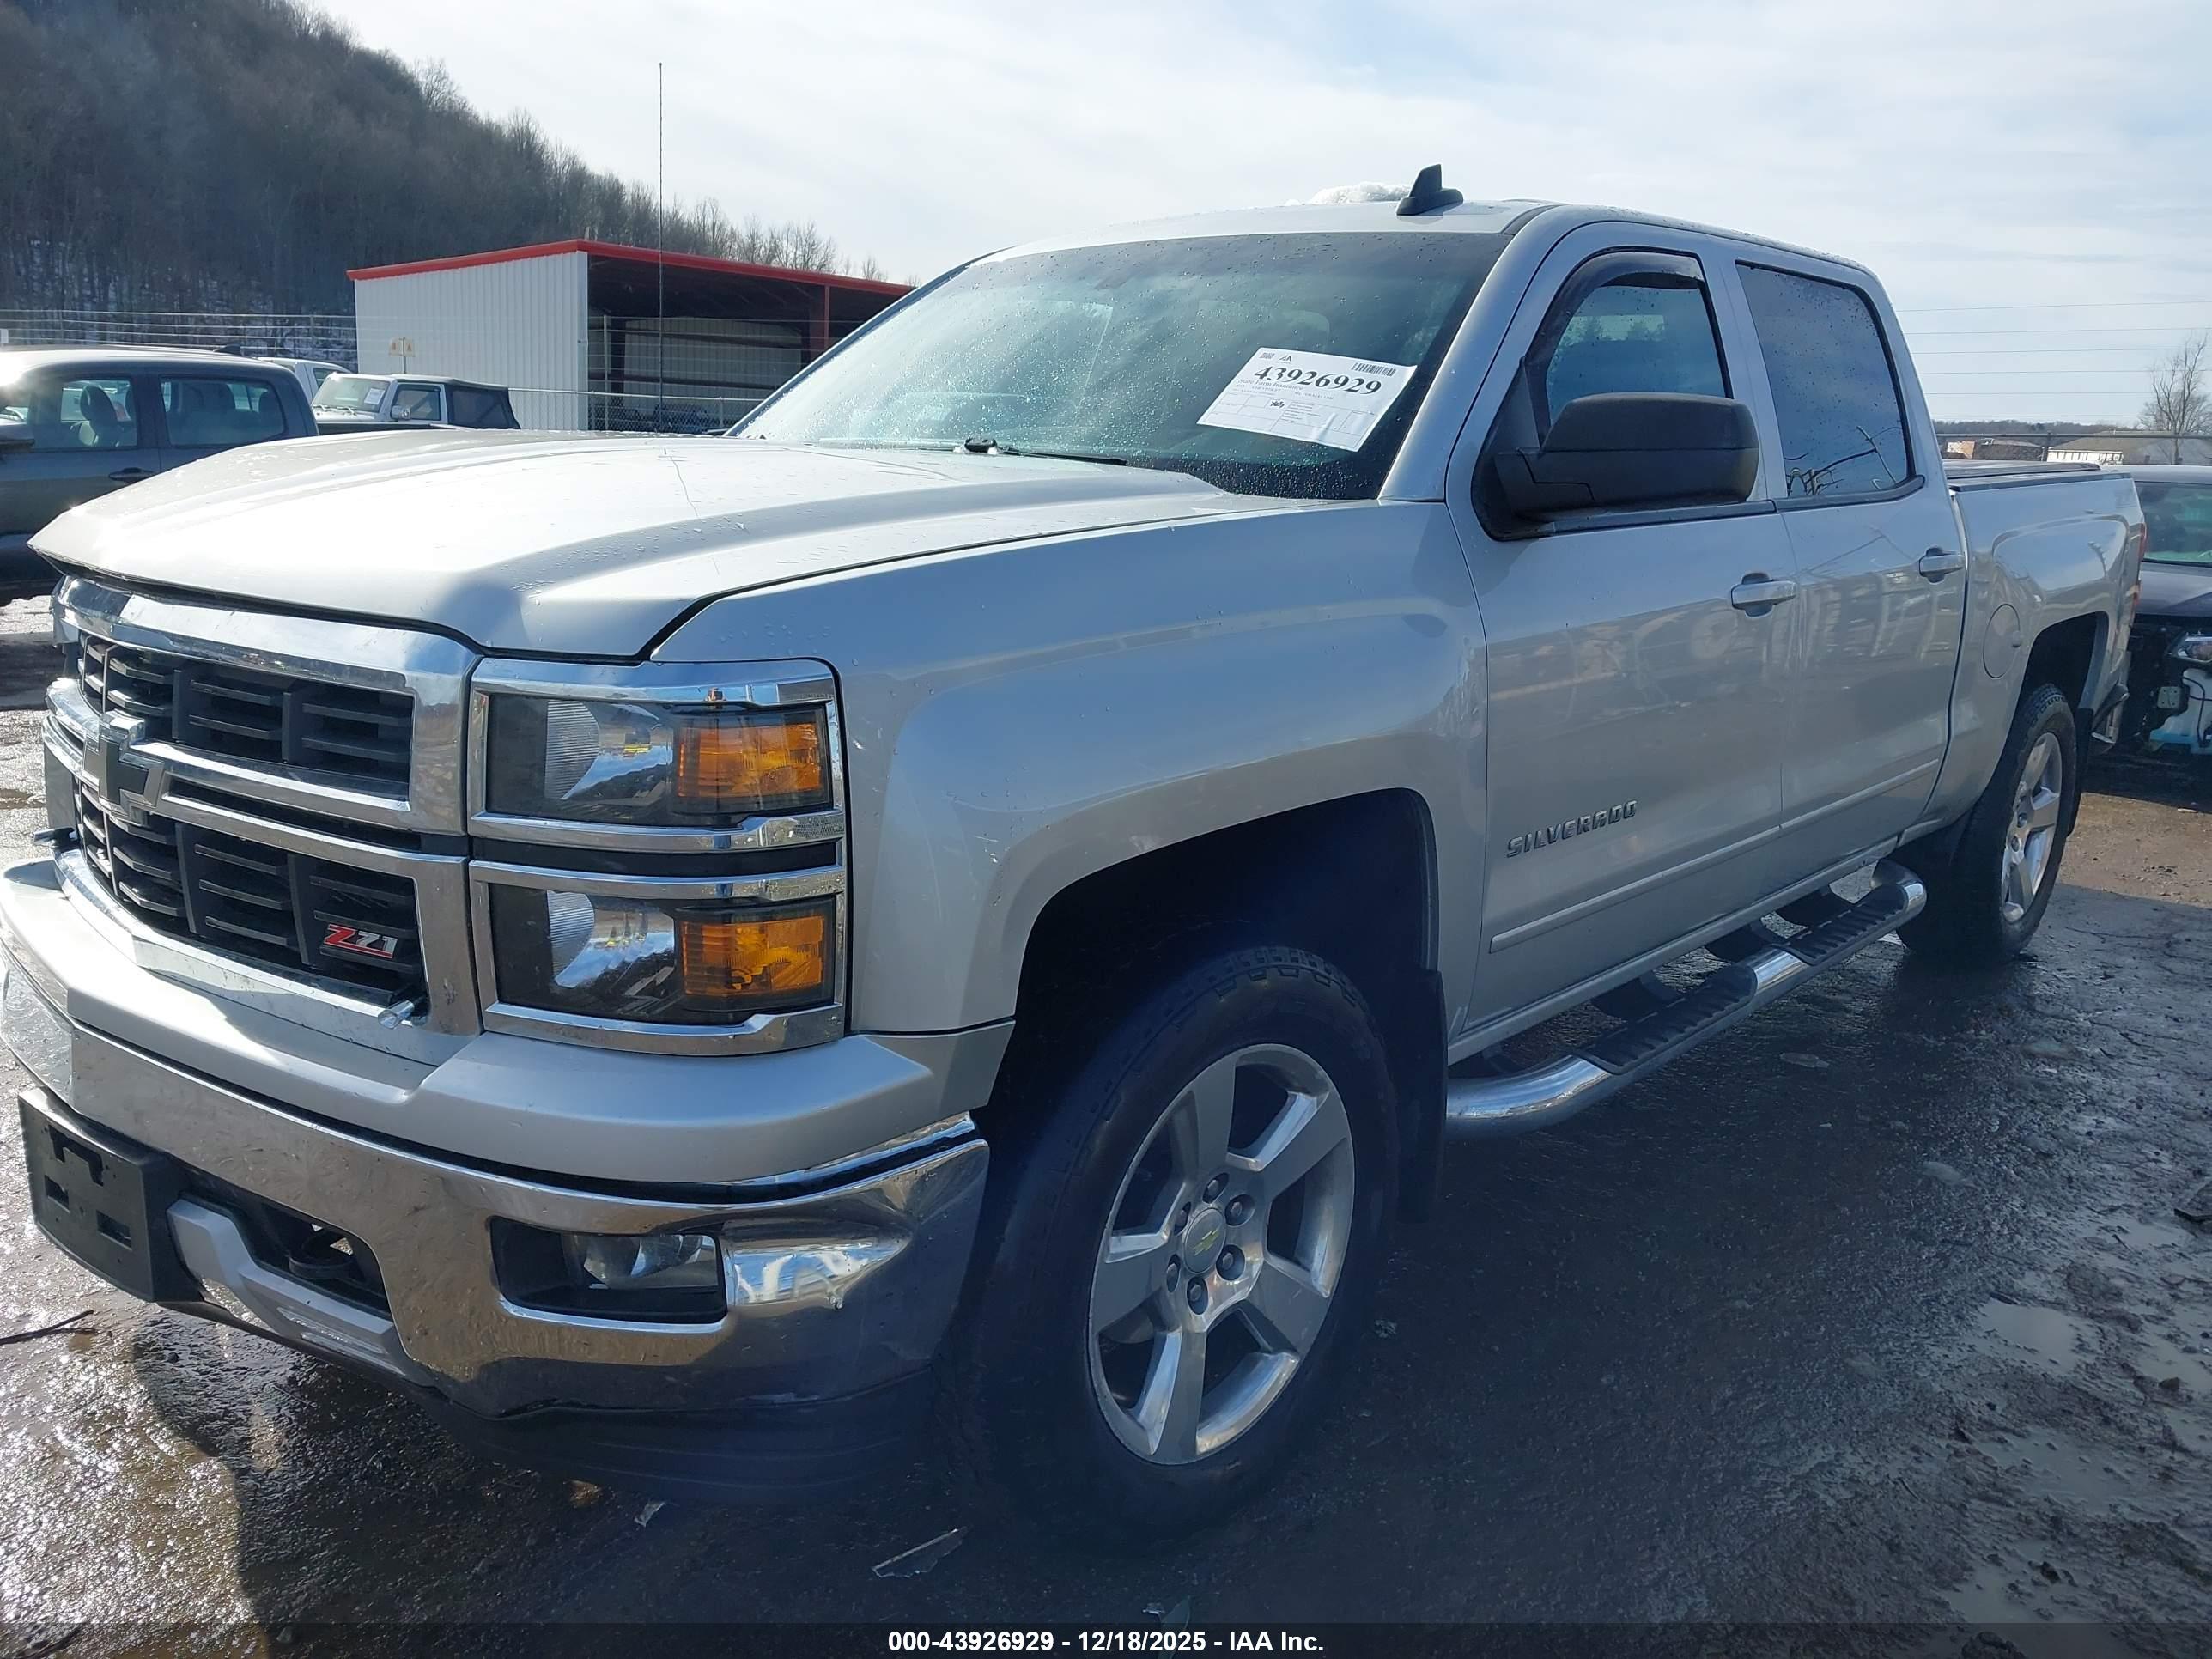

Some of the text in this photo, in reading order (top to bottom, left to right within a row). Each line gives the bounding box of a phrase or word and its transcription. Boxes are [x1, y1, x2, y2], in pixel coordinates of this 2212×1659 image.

[1255, 366, 1382, 394] 43926929
[1273, 382, 1304, 391] Insurance
[1506, 799, 1638, 858] SILVERADO
[323, 923, 398, 959] Z71
